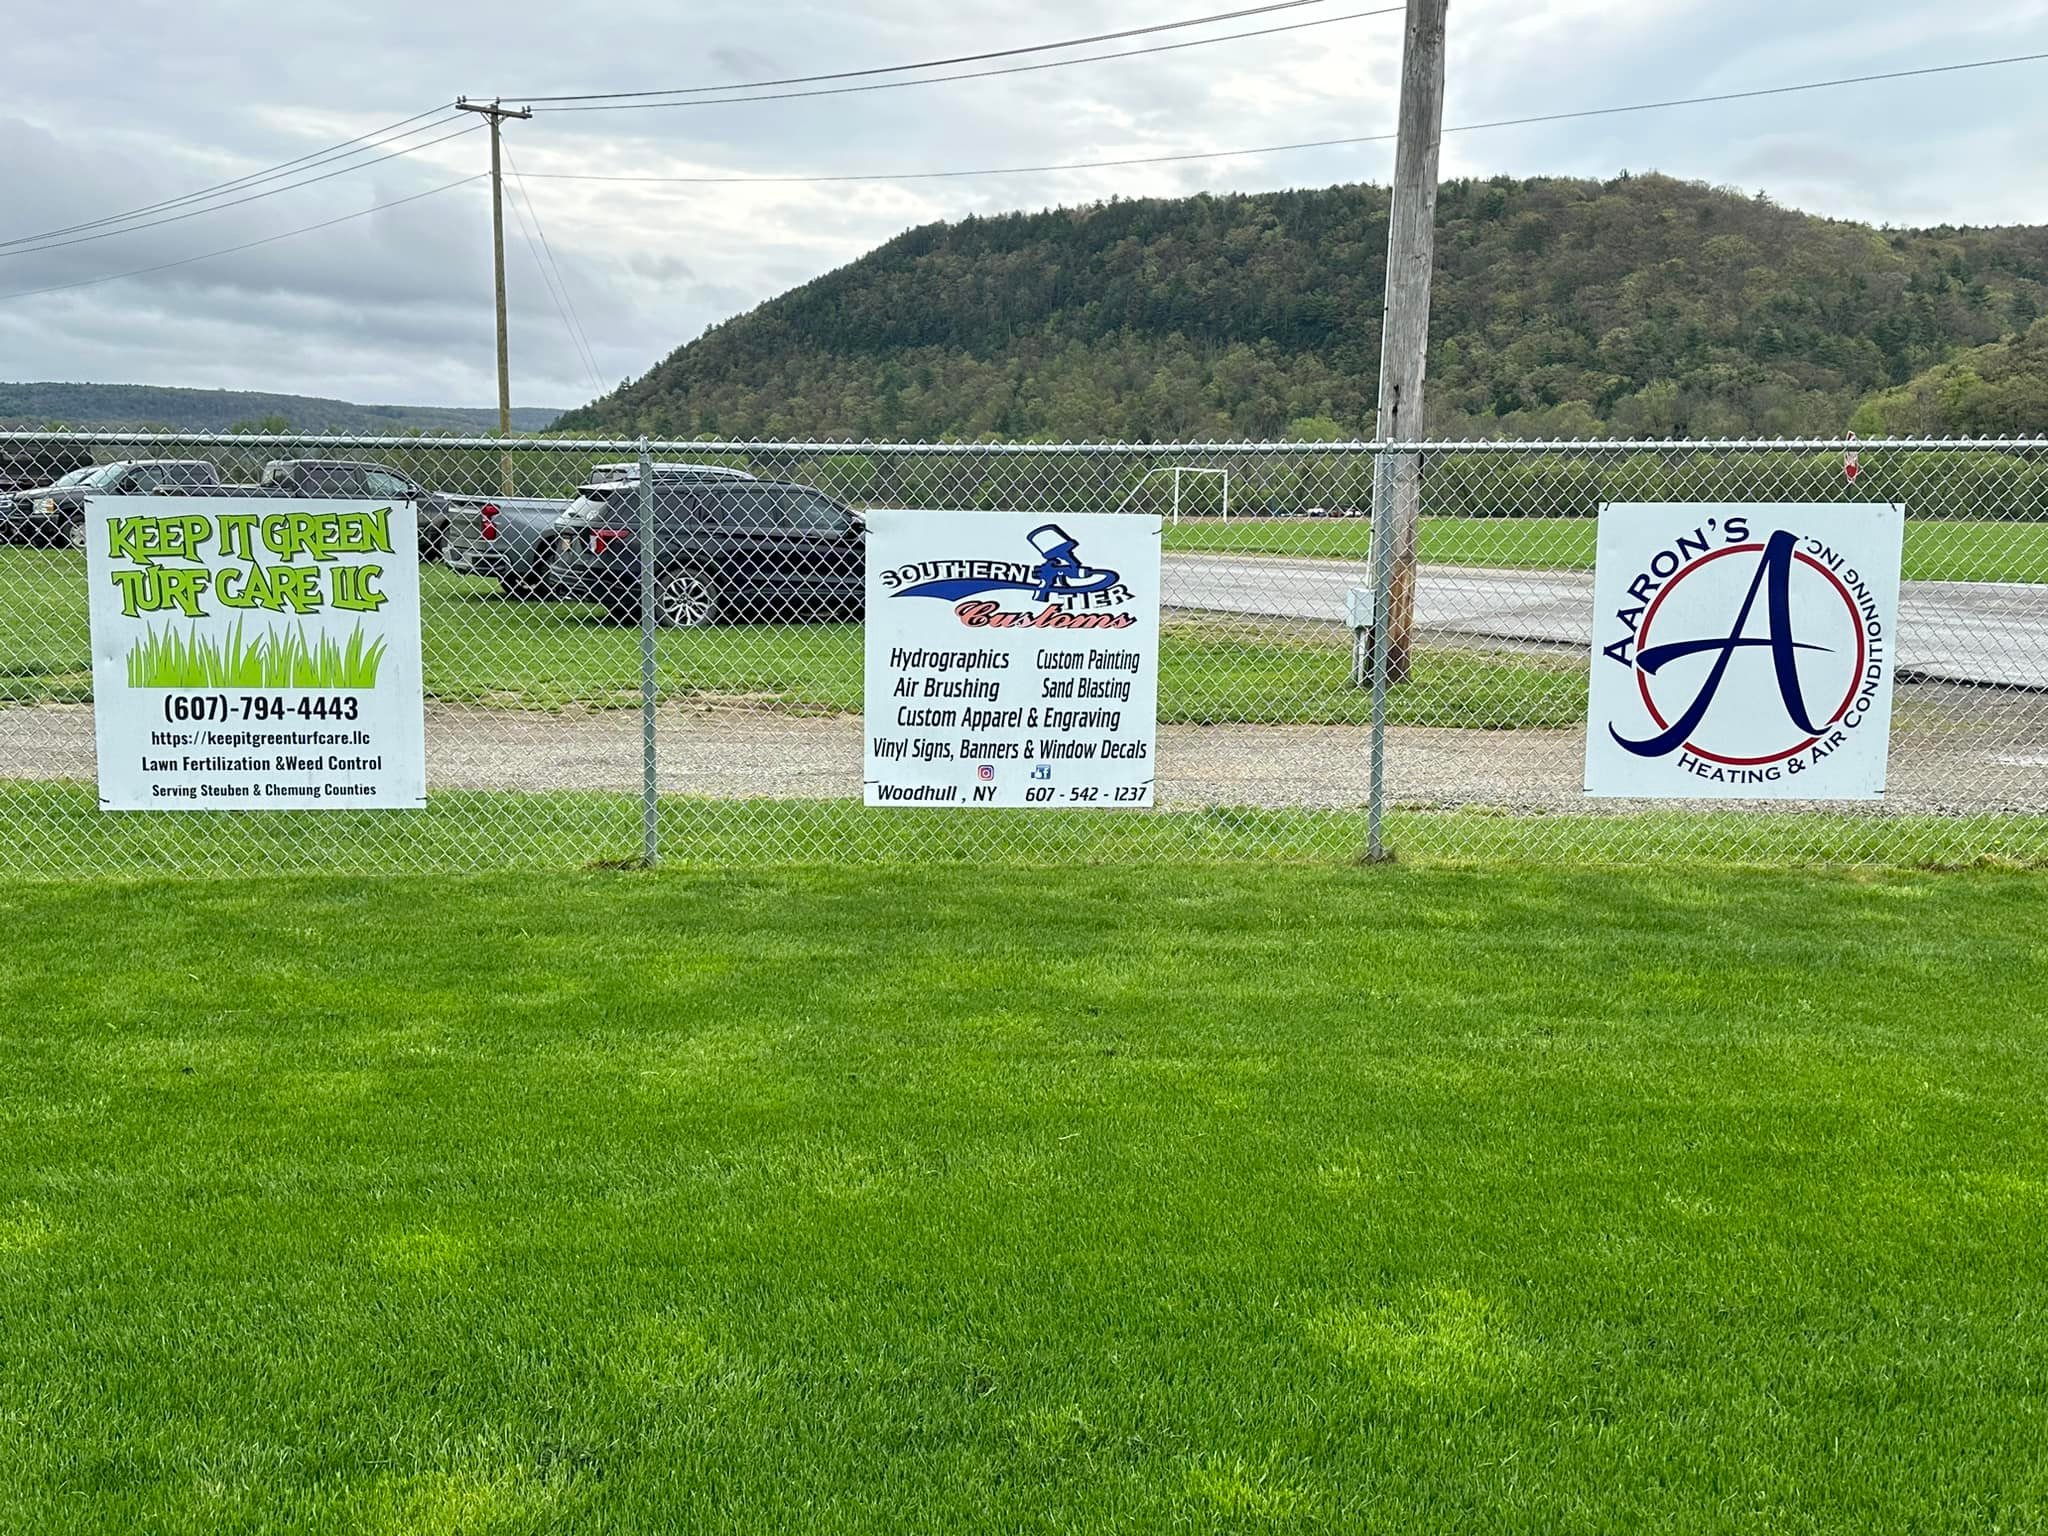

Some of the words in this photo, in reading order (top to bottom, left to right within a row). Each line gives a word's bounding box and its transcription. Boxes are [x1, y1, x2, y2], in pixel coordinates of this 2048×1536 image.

[107, 514, 212, 565] KEEP
[216, 514, 260, 562] IT
[261, 507, 396, 562] GREEN
[1804, 535, 1845, 572] INC.
[879, 560, 1031, 589] SOUTHERN
[111, 564, 211, 618] TURF
[215, 559, 324, 614] CARE
[1060, 585, 1136, 610] TIER
[1603, 517, 1750, 668] AARON'S
[955, 600, 1138, 629] Customs
[890, 648, 1010, 672] Hydrographics
[1036, 648, 1084, 670] Custom
[1087, 649, 1140, 673] Painting
[1843, 569, 1883, 729] CONDITIONING
[893, 677, 919, 698] Air
[924, 678, 1000, 702] Brushing
[1041, 677, 1075, 699] Sand
[1077, 677, 1131, 702] Blasting
[164, 693, 359, 724] (607)-794-4443
[897, 705, 957, 728] Custom
[961, 706, 1022, 732] Apparel
[1026, 707, 1039, 728] &
[1043, 707, 1121, 732] Engraving
[151, 730, 370, 748] https://keepitgreenturfcare.llc
[873, 737, 908, 762] Vinyl
[911, 738, 954, 762] Signs,
[959, 739, 1019, 760] Banners
[1023, 740, 1035, 760] &
[1039, 740, 1097, 760] Window
[1100, 739, 1147, 760] Decals
[1810, 730, 1847, 764] AIR
[142, 756, 178, 772] Lawn
[183, 756, 270, 771] Fertilization
[329, 755, 382, 771] Control
[1677, 752, 1782, 784] HEATING
[1787, 757, 1806, 775] &
[152, 784, 197, 799] Serving
[201, 783, 249, 797] Steuben
[253, 784, 262, 796] &
[265, 784, 321, 799] Chemung
[325, 783, 377, 796] Counties
[877, 785, 957, 801] Woodhull
[972, 786, 998, 802] NY
[1025, 787, 1056, 802] 607
[1069, 787, 1099, 802] 542
[1114, 787, 1147, 802] 1237
